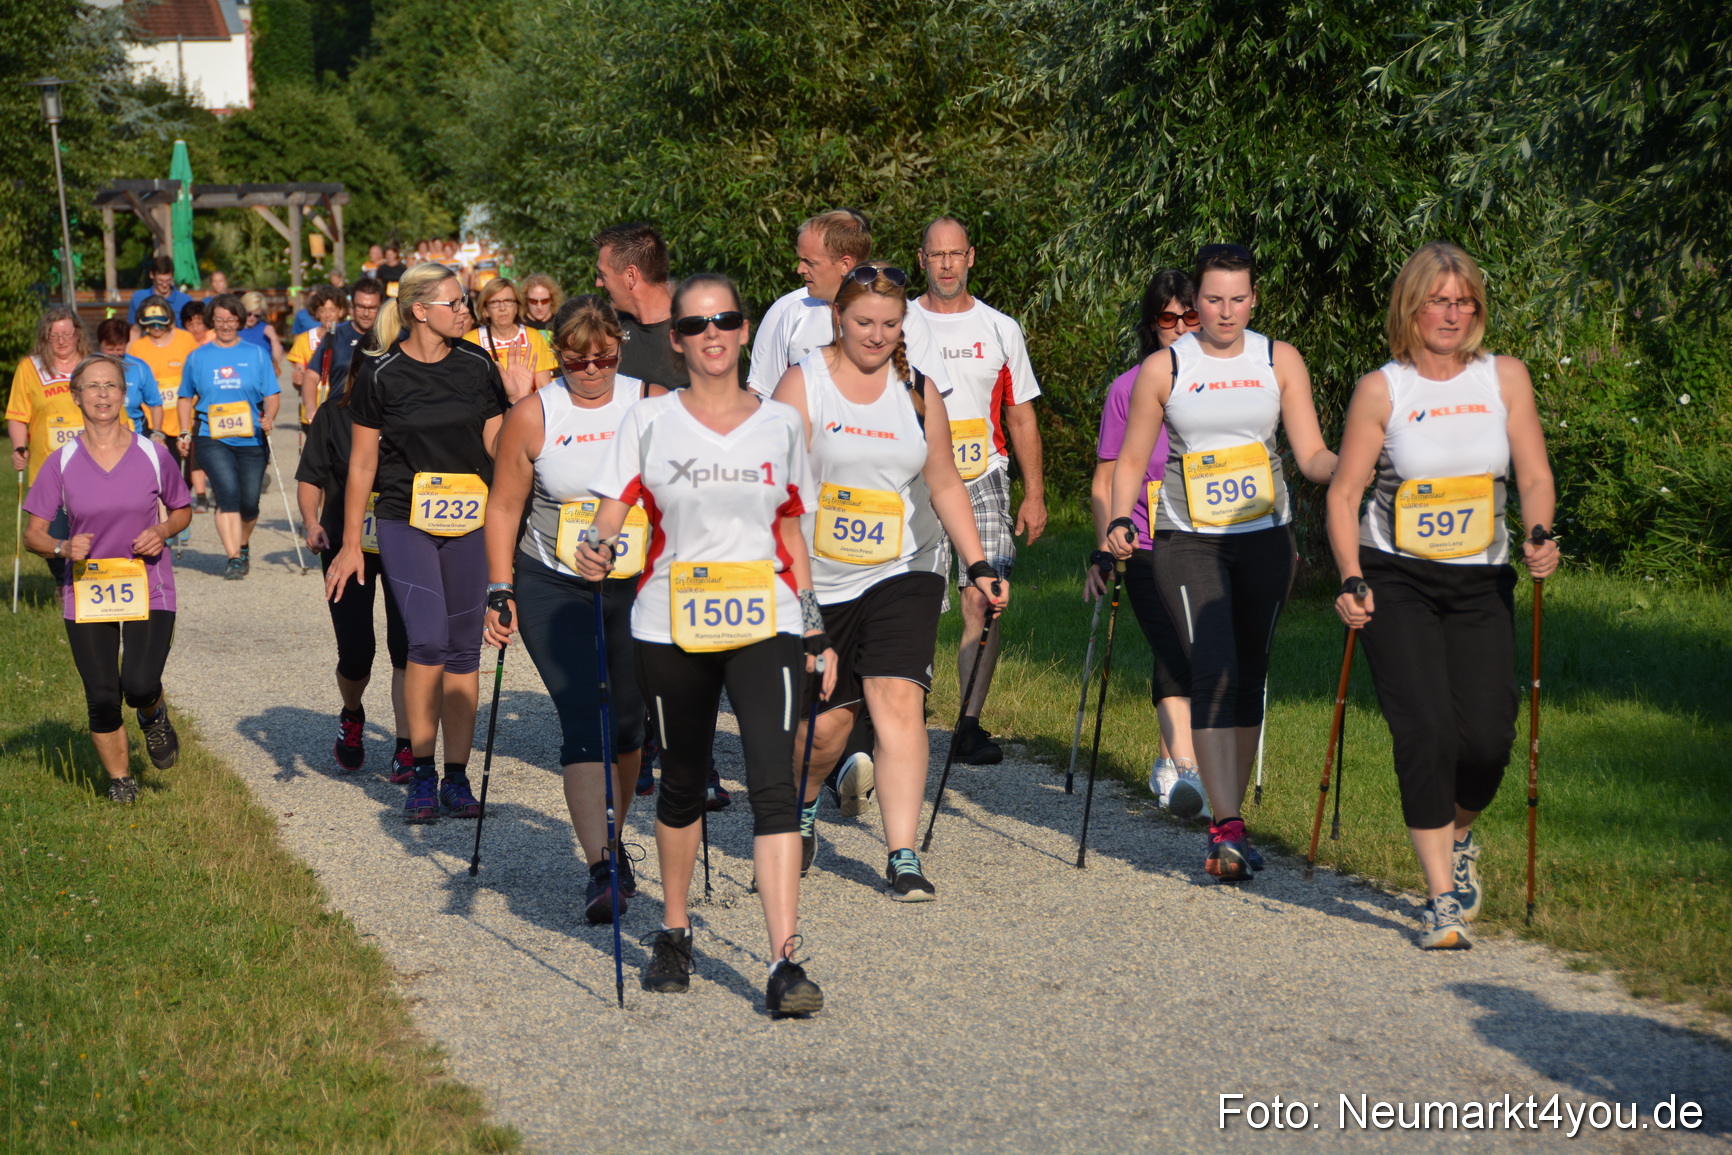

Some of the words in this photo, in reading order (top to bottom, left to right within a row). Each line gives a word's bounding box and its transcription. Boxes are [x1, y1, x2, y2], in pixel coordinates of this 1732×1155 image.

[940, 341, 984, 360] lus1
[213, 369, 219, 380] I
[213, 378, 241, 388] camping
[1208, 379, 1265, 391] KLEBL
[1429, 404, 1493, 418] KLEBL
[218, 416, 243, 430] 494
[576, 431, 616, 443] KLE
[844, 426, 900, 440] KLEBL
[952, 442, 982, 463] 13
[667, 458, 776, 489] Xplus1
[1206, 475, 1257, 506] 596
[421, 499, 480, 519] 1232
[1401, 502, 1430, 510] walken
[832, 516, 885, 545] 594
[1416, 508, 1475, 538] 597
[90, 582, 134, 605] 315
[683, 598, 765, 627] 1505
